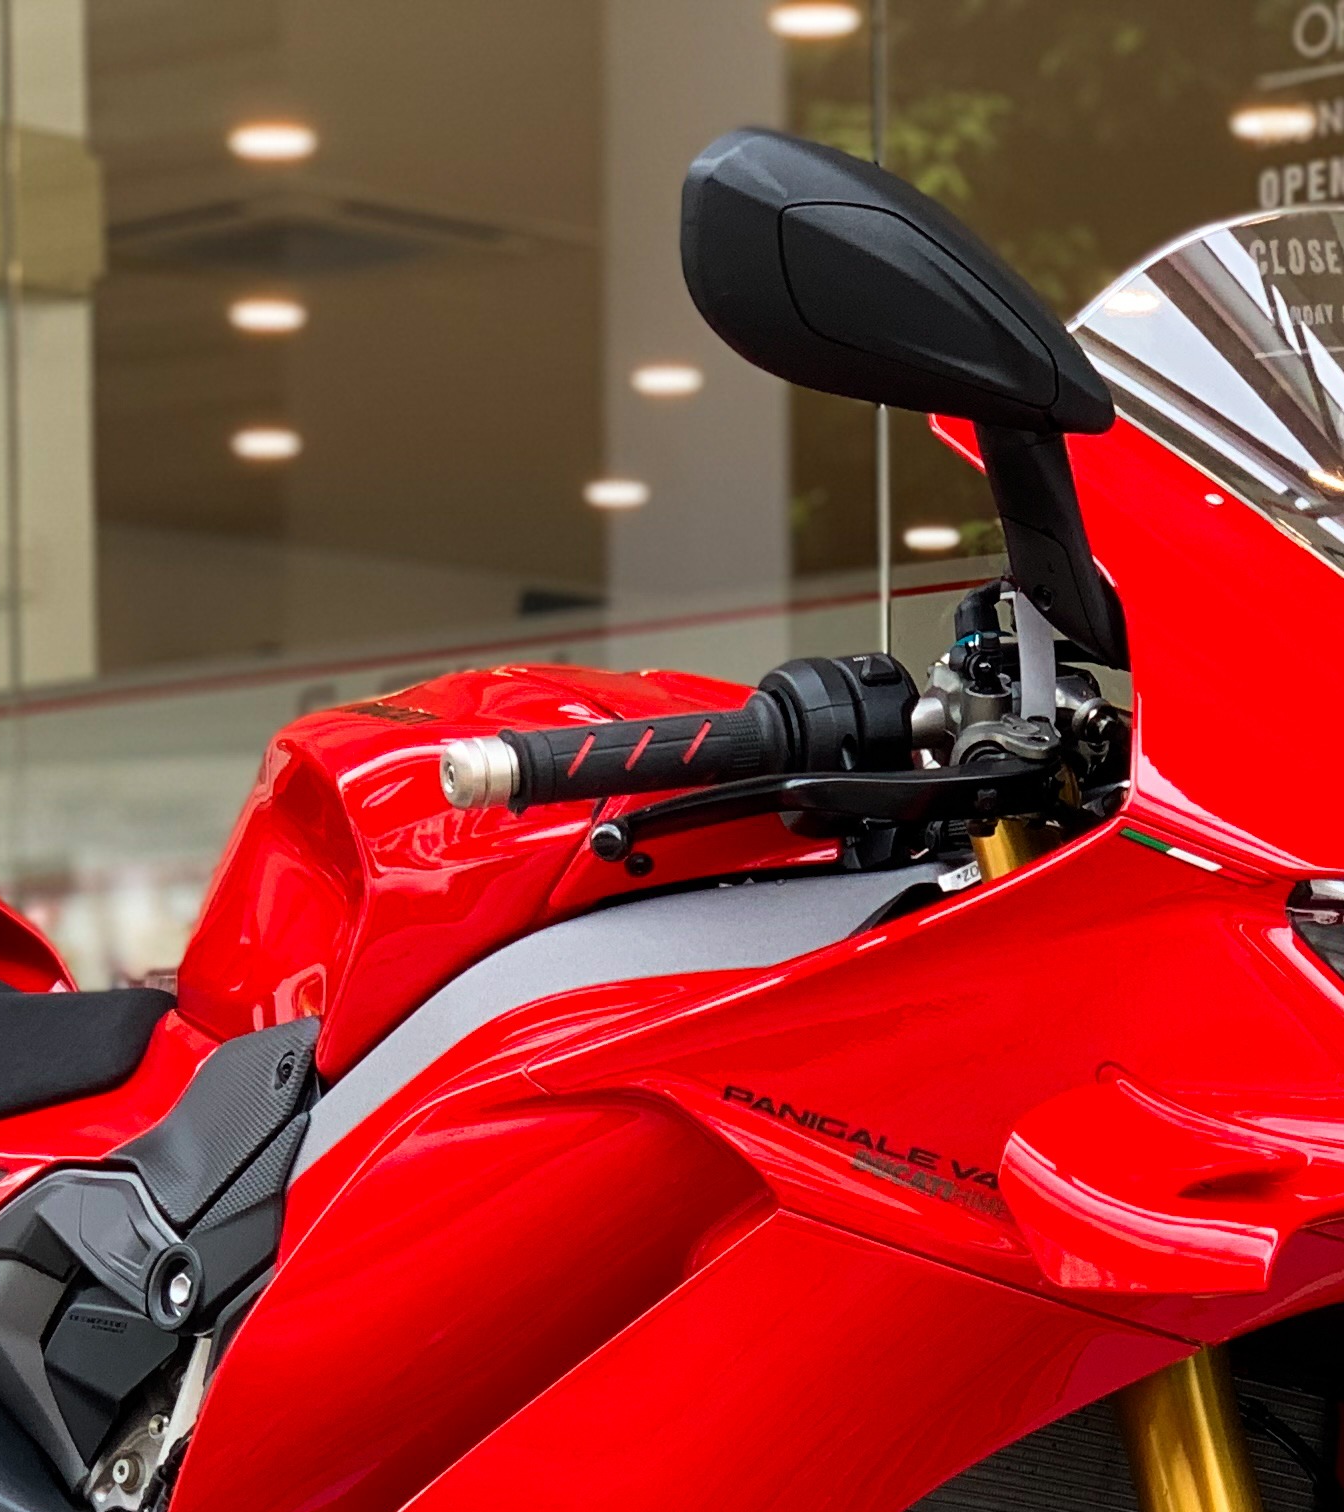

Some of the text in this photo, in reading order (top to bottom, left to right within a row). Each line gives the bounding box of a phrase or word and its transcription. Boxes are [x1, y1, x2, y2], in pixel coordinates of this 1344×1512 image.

[1248, 237, 1344, 276] CLOSE
[722, 1085, 999, 1191] PANIGALE V4
